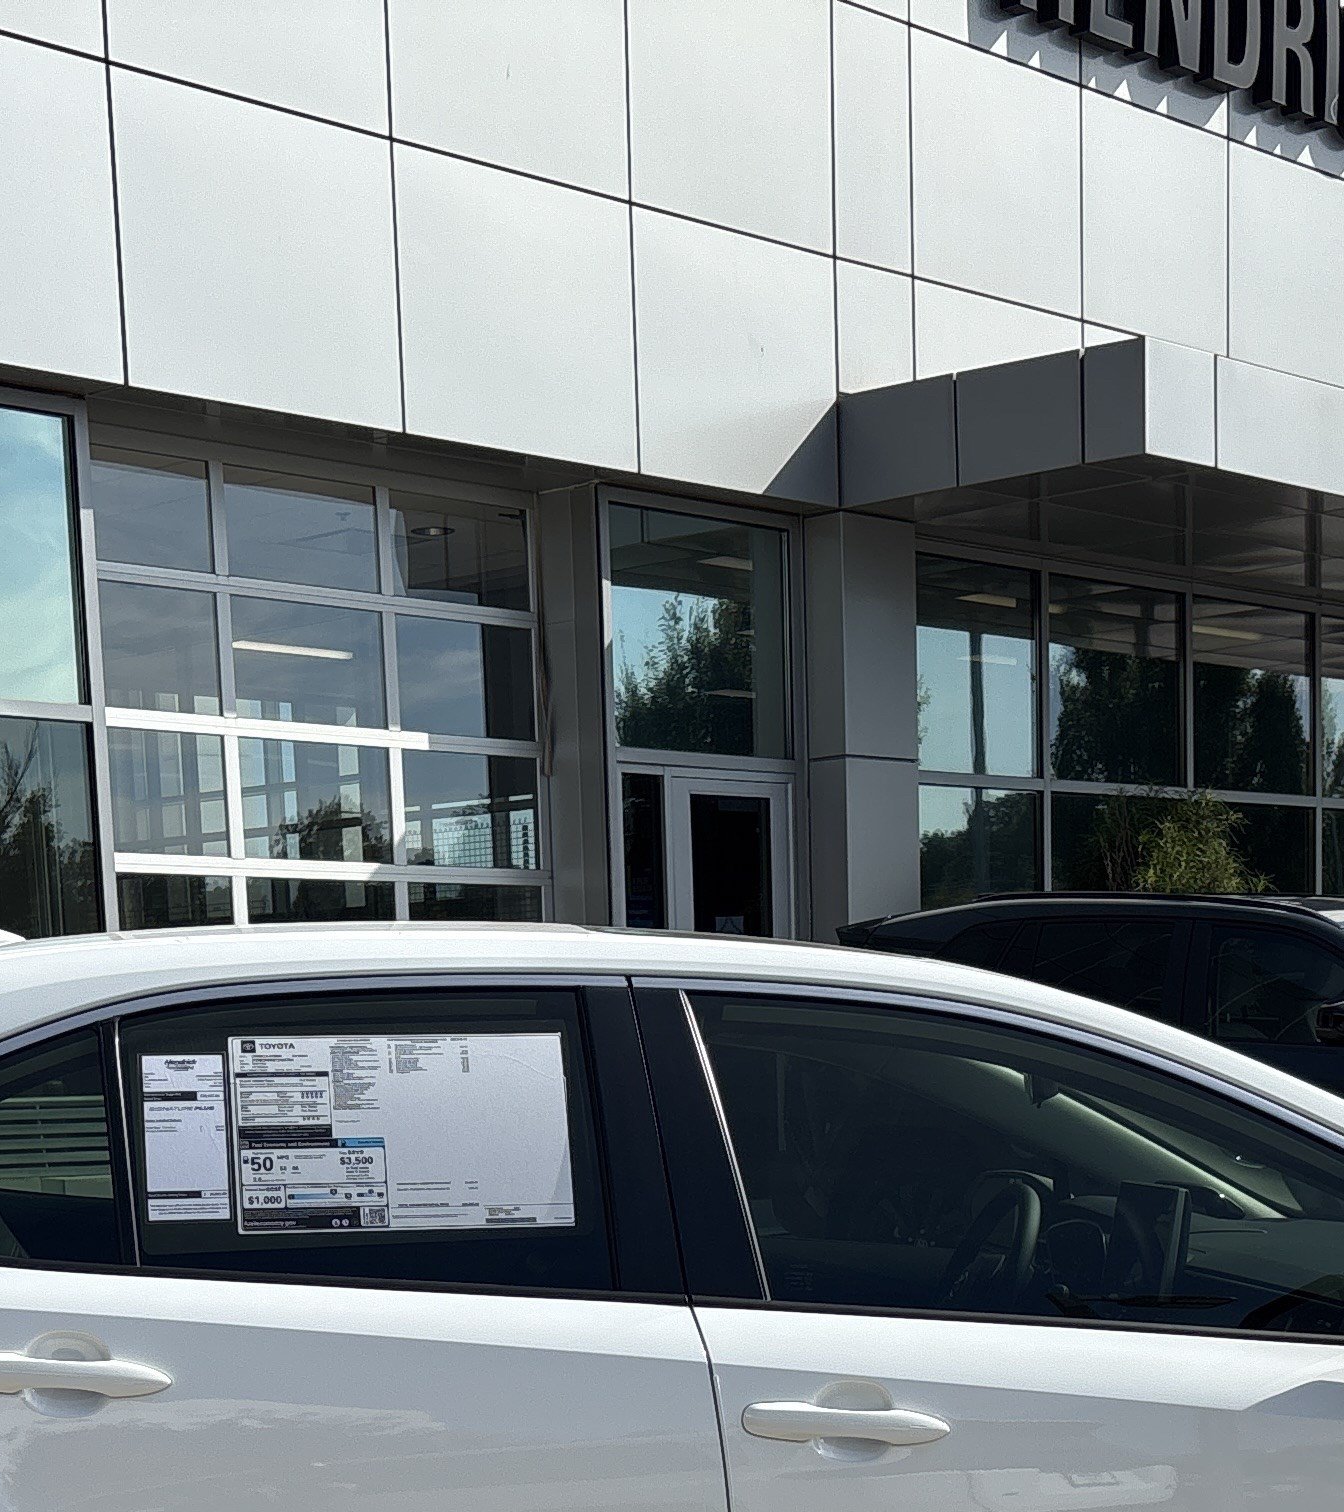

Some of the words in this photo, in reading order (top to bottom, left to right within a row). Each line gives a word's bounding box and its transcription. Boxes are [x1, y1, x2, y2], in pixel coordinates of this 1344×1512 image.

[258, 1042, 296, 1051] TOYOTA
[250, 1156, 274, 1172] 50
[339, 1156, 374, 1166] $3,500
[247, 1195, 283, 1206] $1,000
